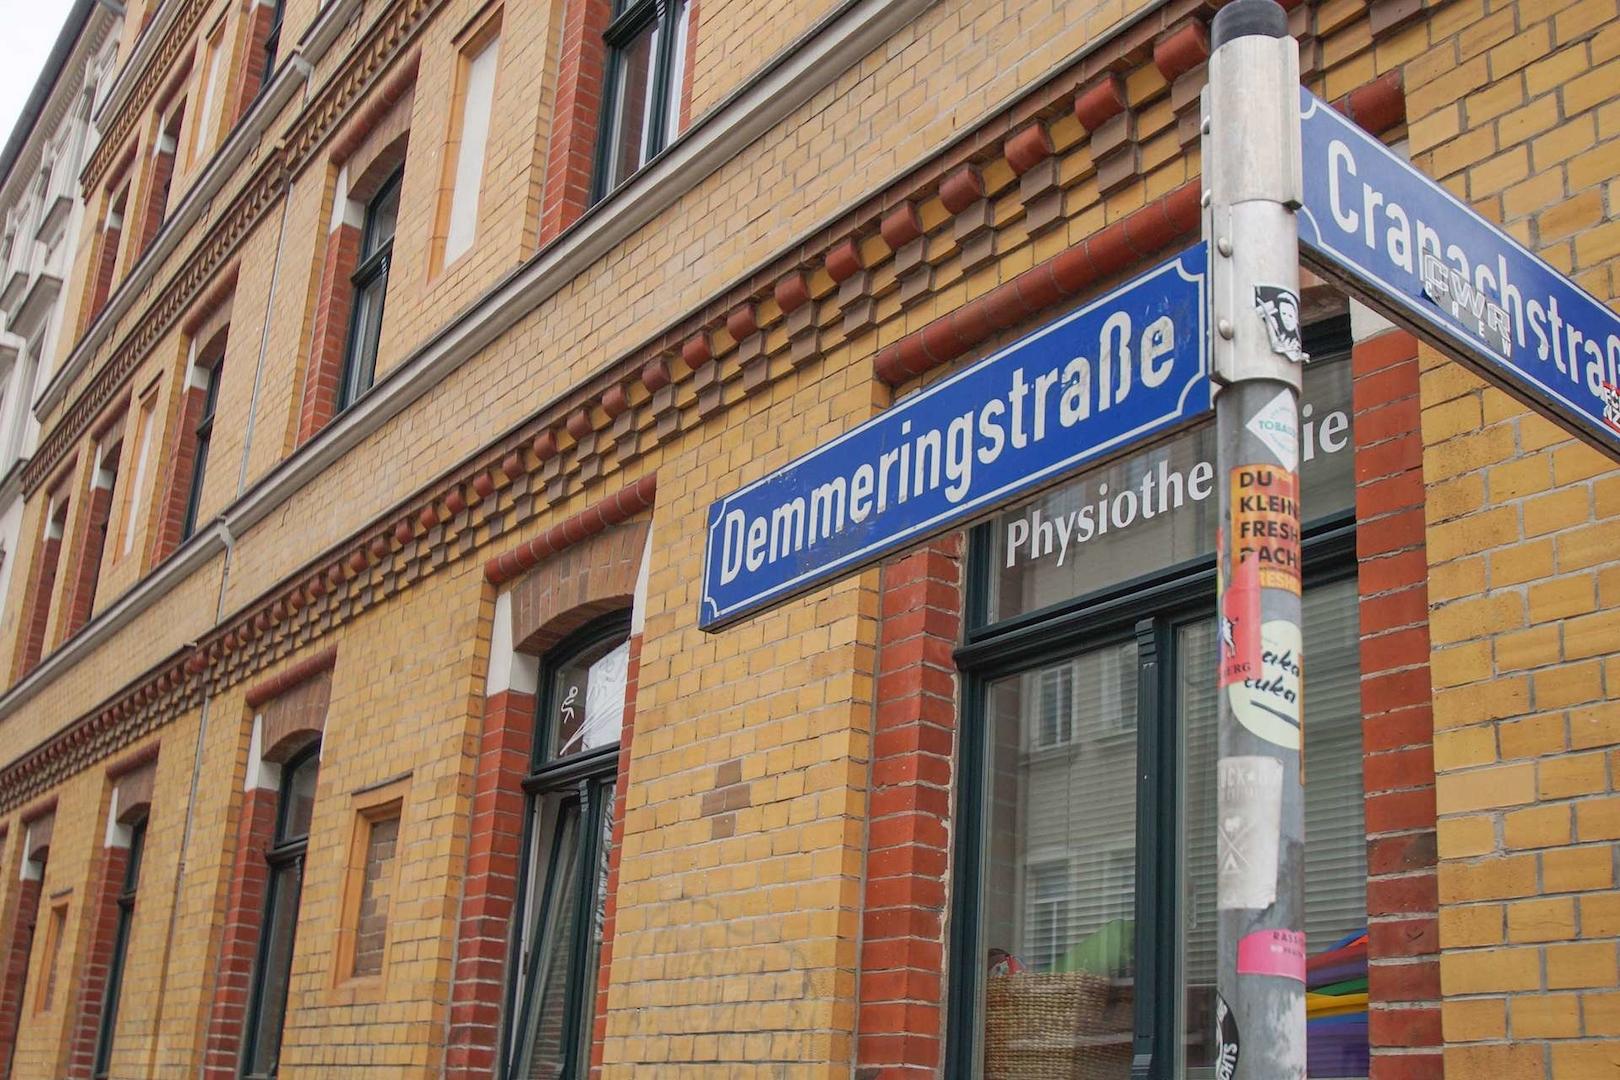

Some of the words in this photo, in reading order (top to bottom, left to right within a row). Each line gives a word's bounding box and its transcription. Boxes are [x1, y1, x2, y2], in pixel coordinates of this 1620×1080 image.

[720, 311, 1175, 587] Demmeringstraße
[1006, 403, 1349, 568] Physiotheie
[1240, 471, 1272, 488] DU
[1240, 521, 1299, 544] FRESH
